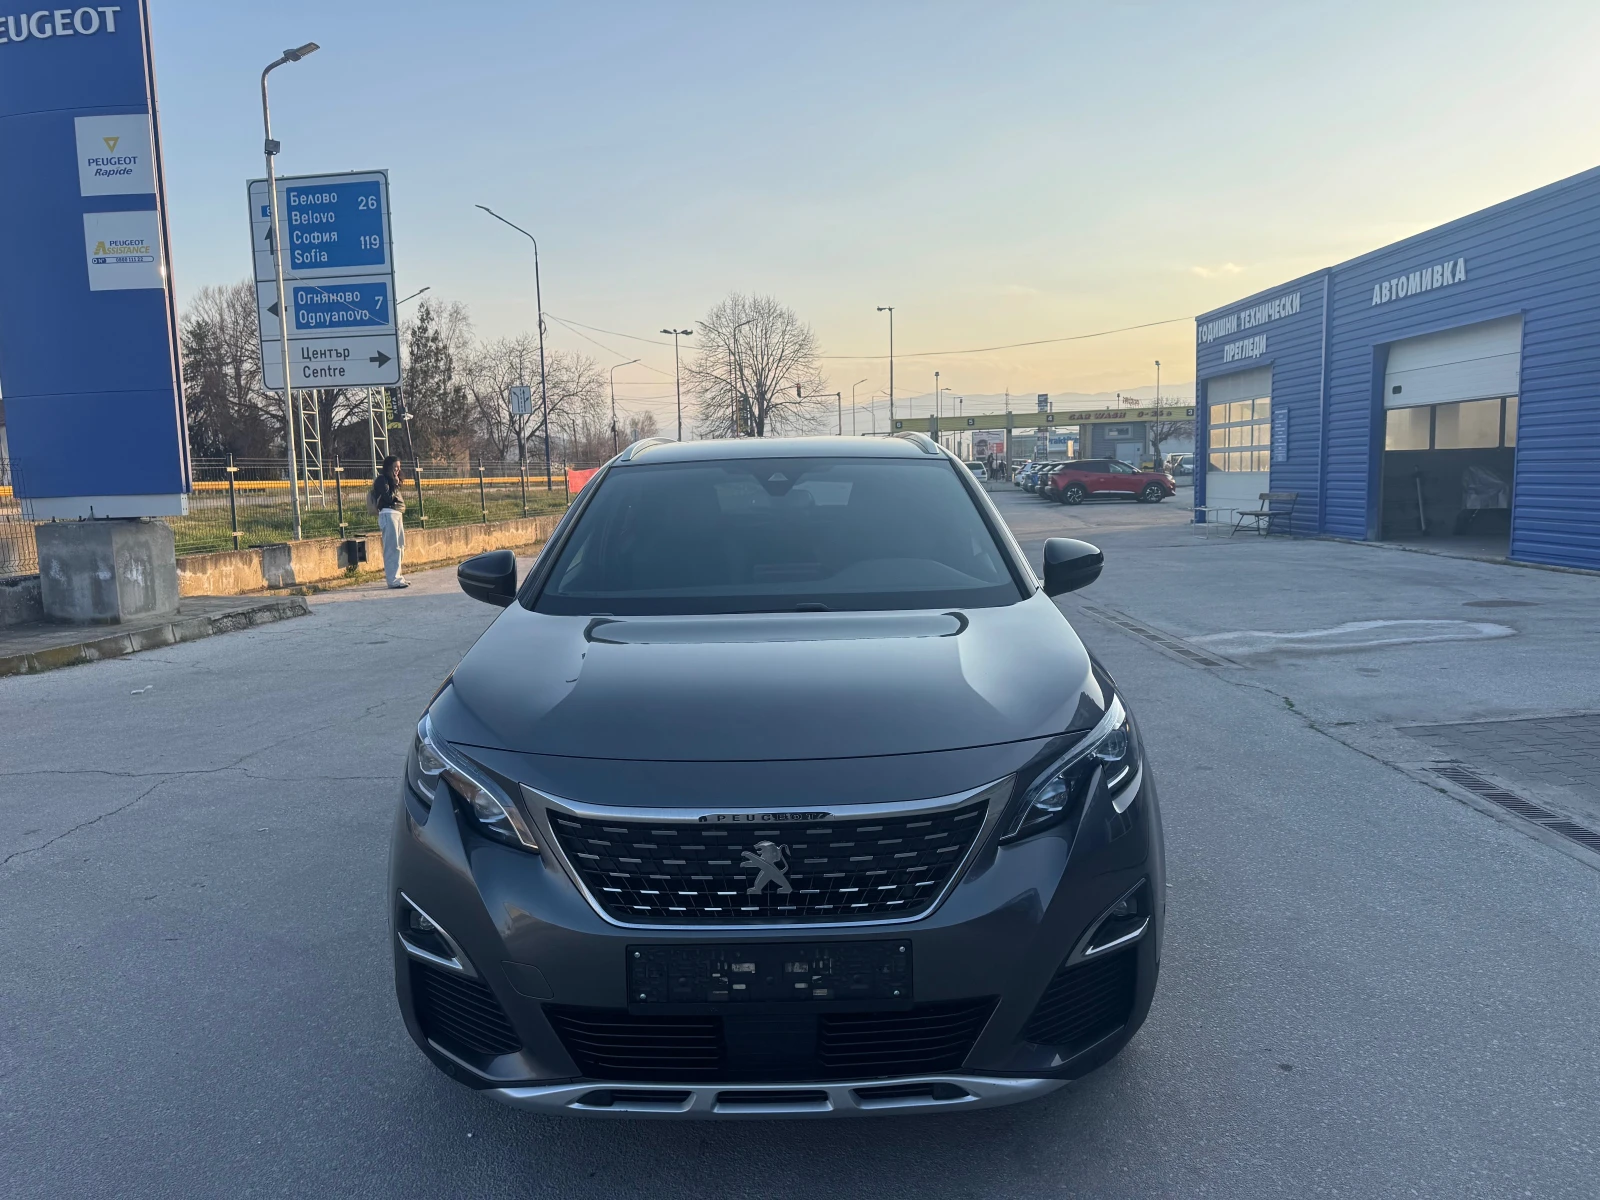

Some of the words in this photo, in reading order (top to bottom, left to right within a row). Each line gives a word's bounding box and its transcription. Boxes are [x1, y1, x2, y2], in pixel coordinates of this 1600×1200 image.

[87, 156, 138, 167] PEUGEOT
[94, 167, 133, 177] Rapide
[290, 192, 338, 206] Белово
[358, 195, 377, 210] 26
[291, 210, 335, 225] Belovo
[109, 239, 144, 247] PEUGEOT
[293, 230, 338, 245] София
[360, 235, 380, 249] 119
[294, 249, 328, 264] Sofia
[1371, 257, 1466, 306] АВТОМИВКА
[297, 291, 360, 305] Огняново
[374, 296, 383, 310] 7
[299, 310, 369, 326] Ognyanovo
[1198, 314, 1237, 343] ГОДИШНИ
[1240, 292, 1300, 330] ТЕХНИЧЕСКИ
[301, 346, 350, 361] Център
[1223, 334, 1267, 363] ПРЕГЛЕДИ
[303, 365, 346, 379] Centre
